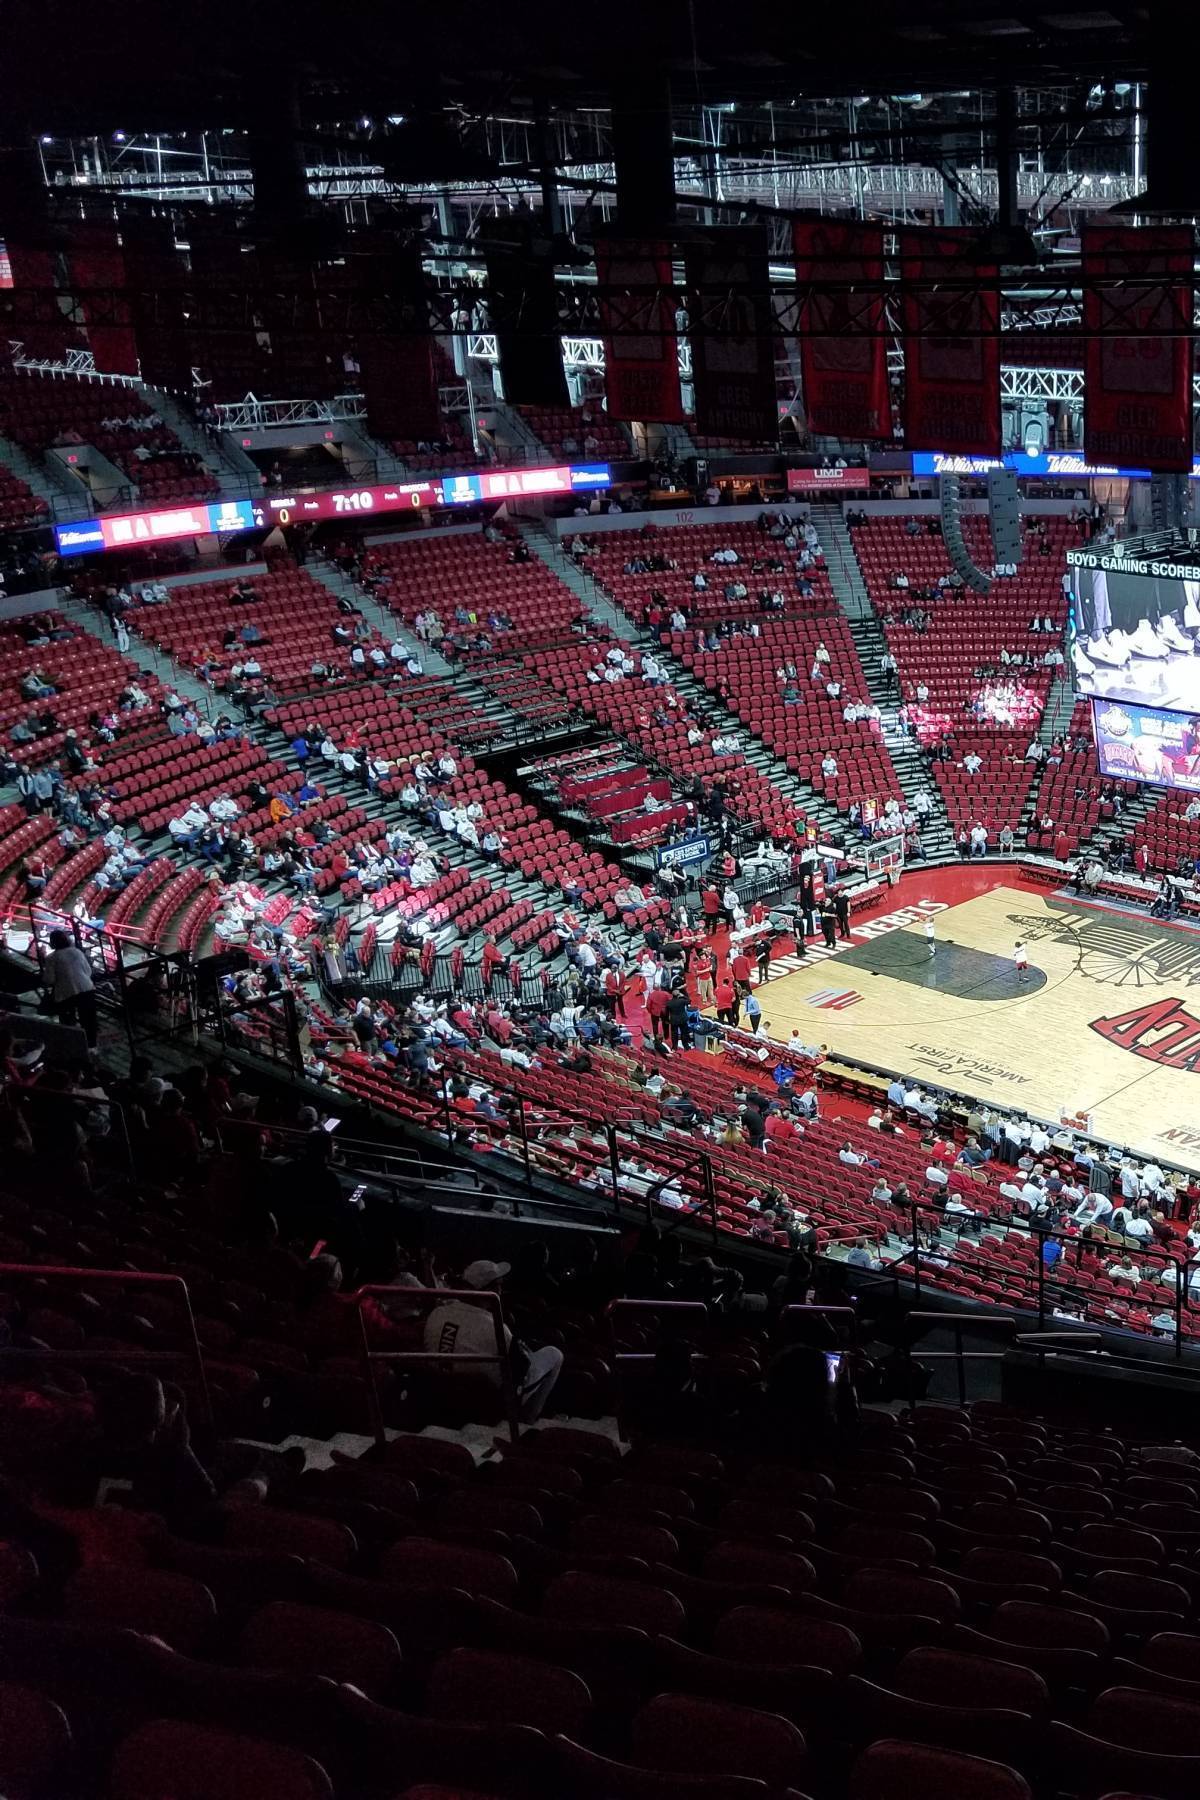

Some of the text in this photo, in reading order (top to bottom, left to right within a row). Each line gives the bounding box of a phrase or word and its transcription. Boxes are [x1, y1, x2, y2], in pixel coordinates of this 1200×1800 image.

[813, 468, 844, 479] UMC
[332, 491, 374, 512] 7:10
[410, 492, 421, 507] 0
[279, 508, 290, 524] 0
[675, 511, 694, 523] 102
[1066, 552, 1098, 568] BOYD
[1101, 559, 1149, 575] GAMING
[850, 899, 950, 940] REBELS
[904, 1042, 1033, 1084] AMERICA FIRST
